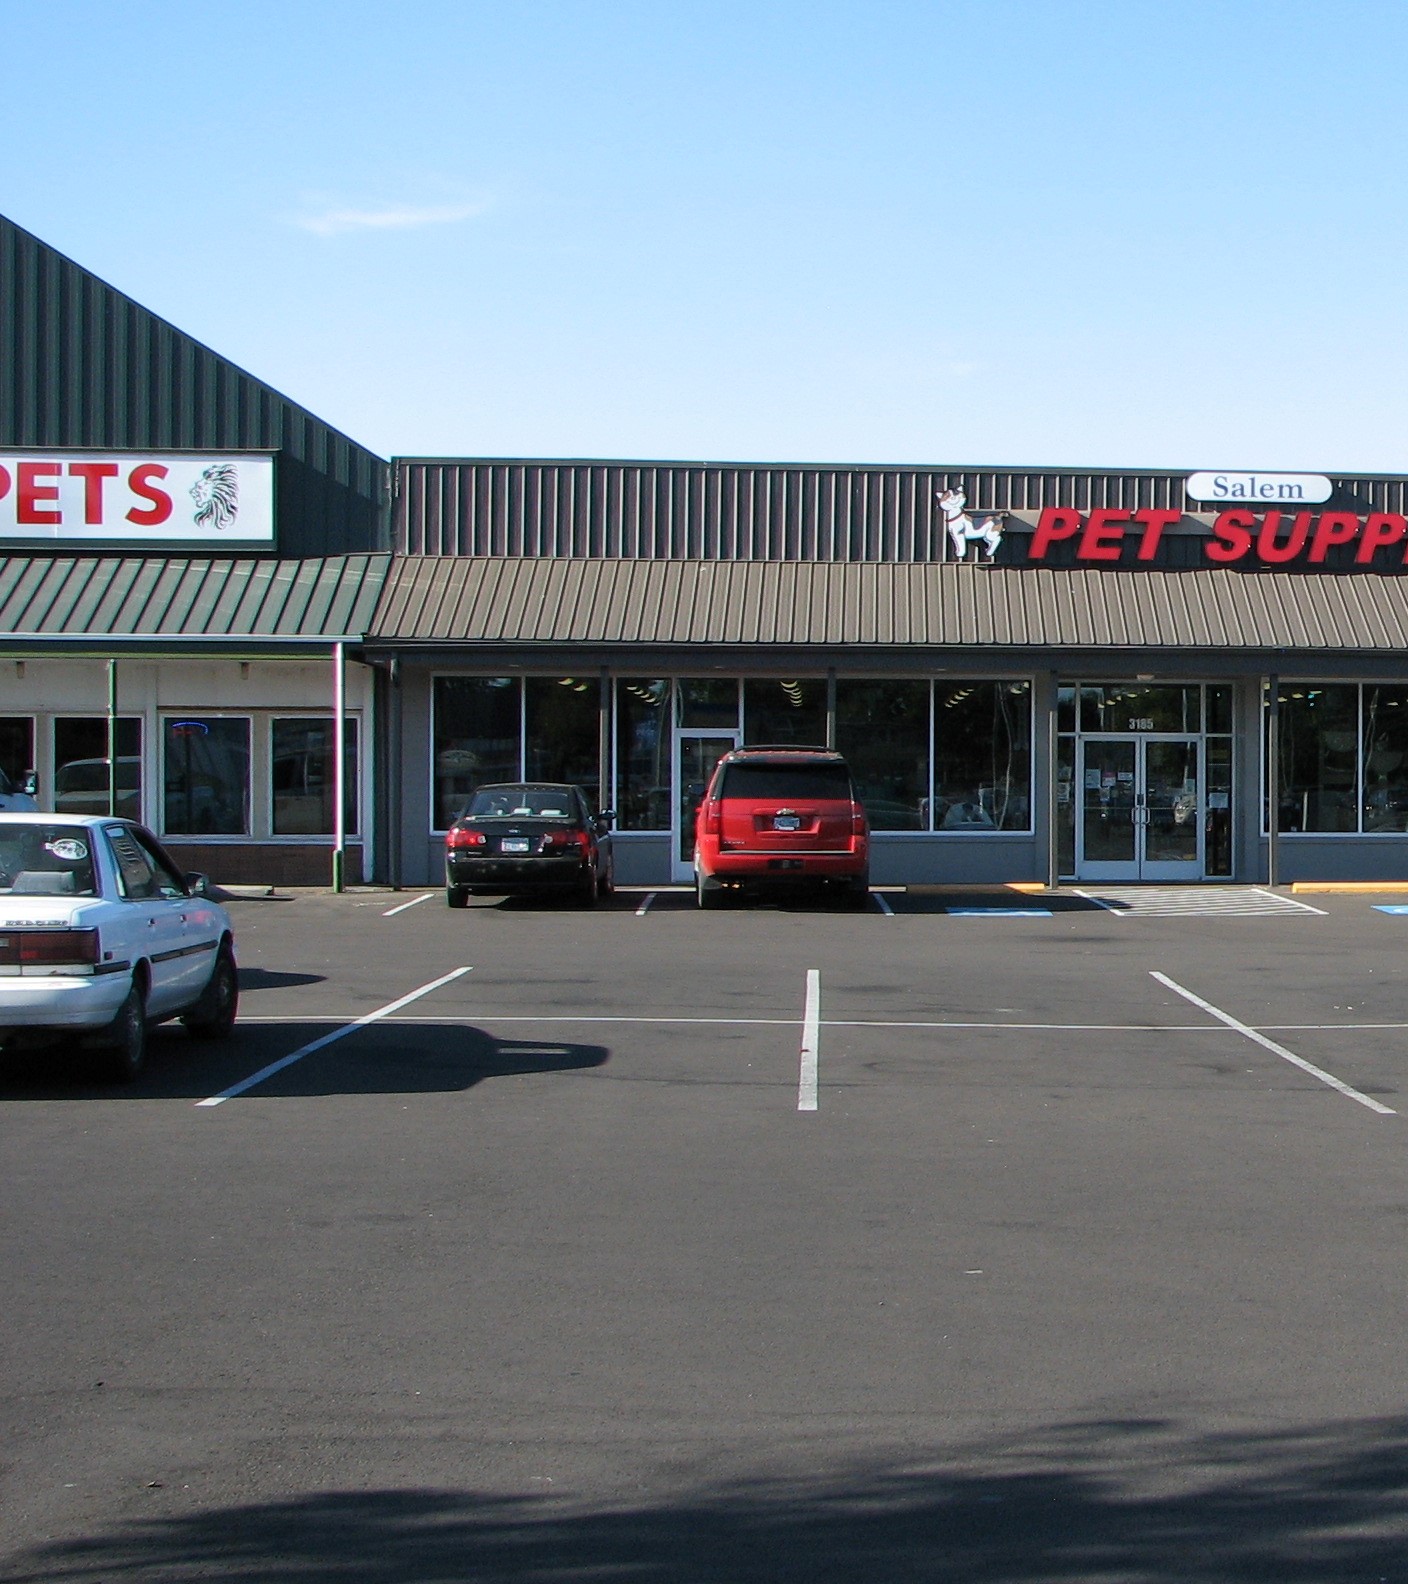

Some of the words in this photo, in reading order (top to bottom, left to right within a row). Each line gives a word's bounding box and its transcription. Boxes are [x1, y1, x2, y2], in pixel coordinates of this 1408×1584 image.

[0, 462, 173, 526] ETS
[1212, 475, 1304, 499] Salem
[1027, 506, 1183, 561] PET
